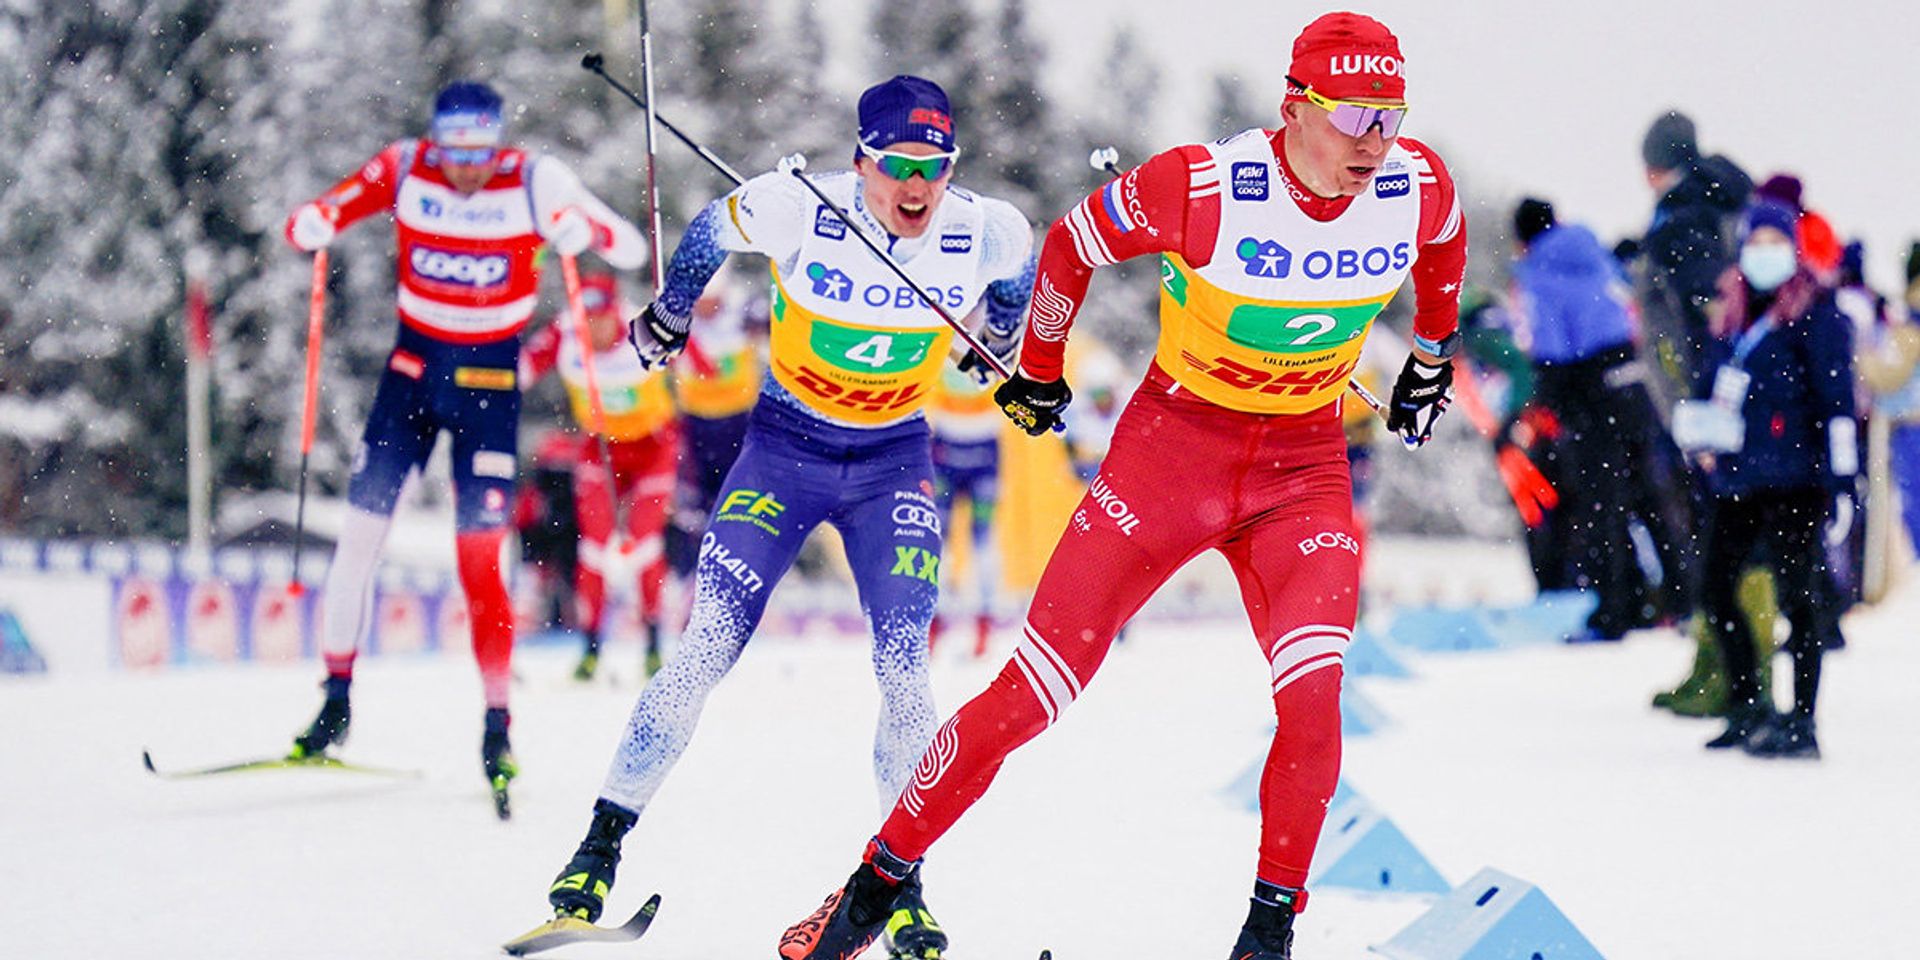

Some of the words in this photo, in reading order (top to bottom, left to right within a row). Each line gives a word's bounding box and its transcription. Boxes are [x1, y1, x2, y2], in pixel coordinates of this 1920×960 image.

[1377, 179, 1408, 191] coop
[410, 247, 509, 288] coop
[1302, 242, 1410, 280] OBOS
[863, 284, 965, 309] OBOS
[1284, 313, 1338, 346] 2
[844, 334, 895, 368] 4
[1263, 352, 1338, 368] LILLEHAMMER
[794, 365, 922, 412] DHL
[1208, 356, 1353, 397] DHL
[719, 490, 785, 517] FF
[893, 527, 926, 538] Audi
[708, 543, 764, 594] HALTI
